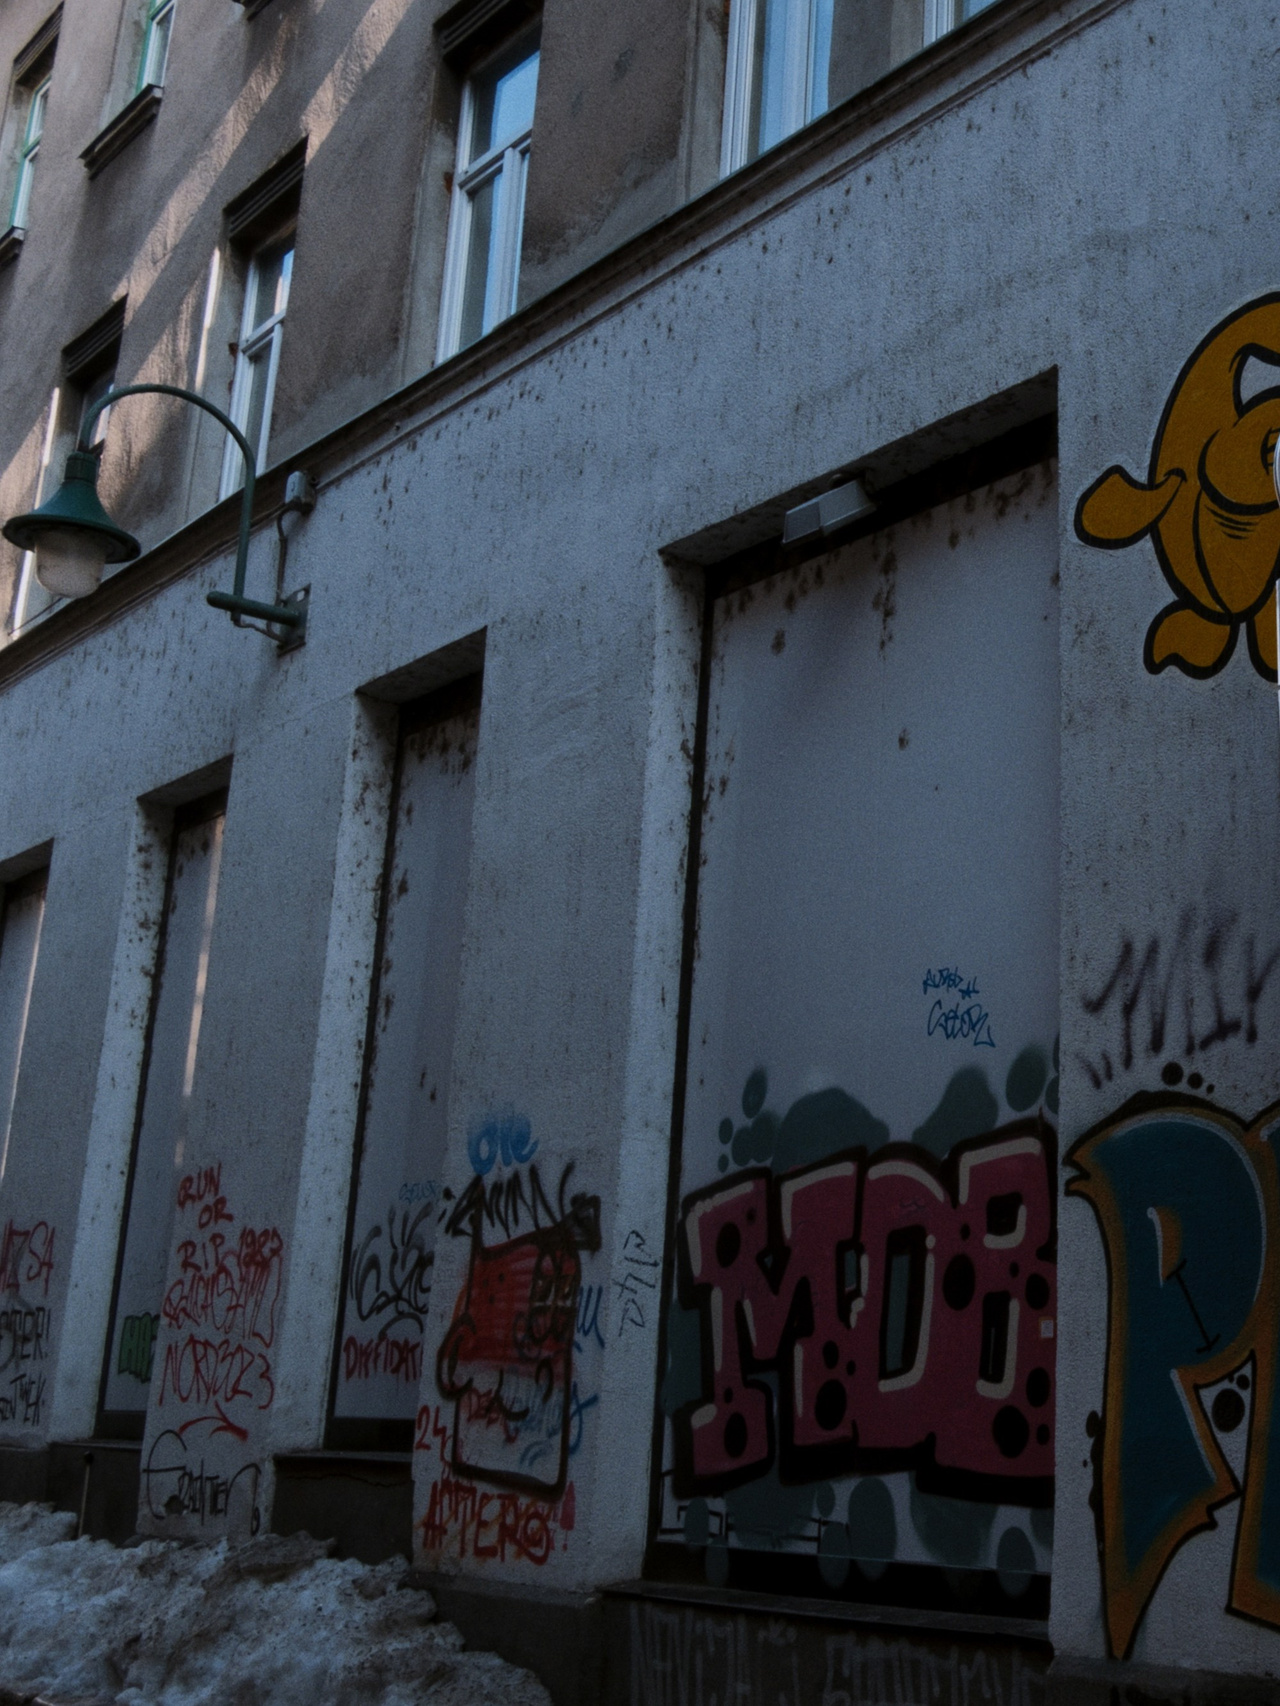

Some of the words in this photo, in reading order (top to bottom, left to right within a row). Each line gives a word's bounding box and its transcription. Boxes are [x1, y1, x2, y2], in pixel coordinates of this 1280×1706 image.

[178, 1162, 222, 1210] RUN
[198, 1195, 234, 1229] OR
[177, 1232, 226, 1273] RIP
